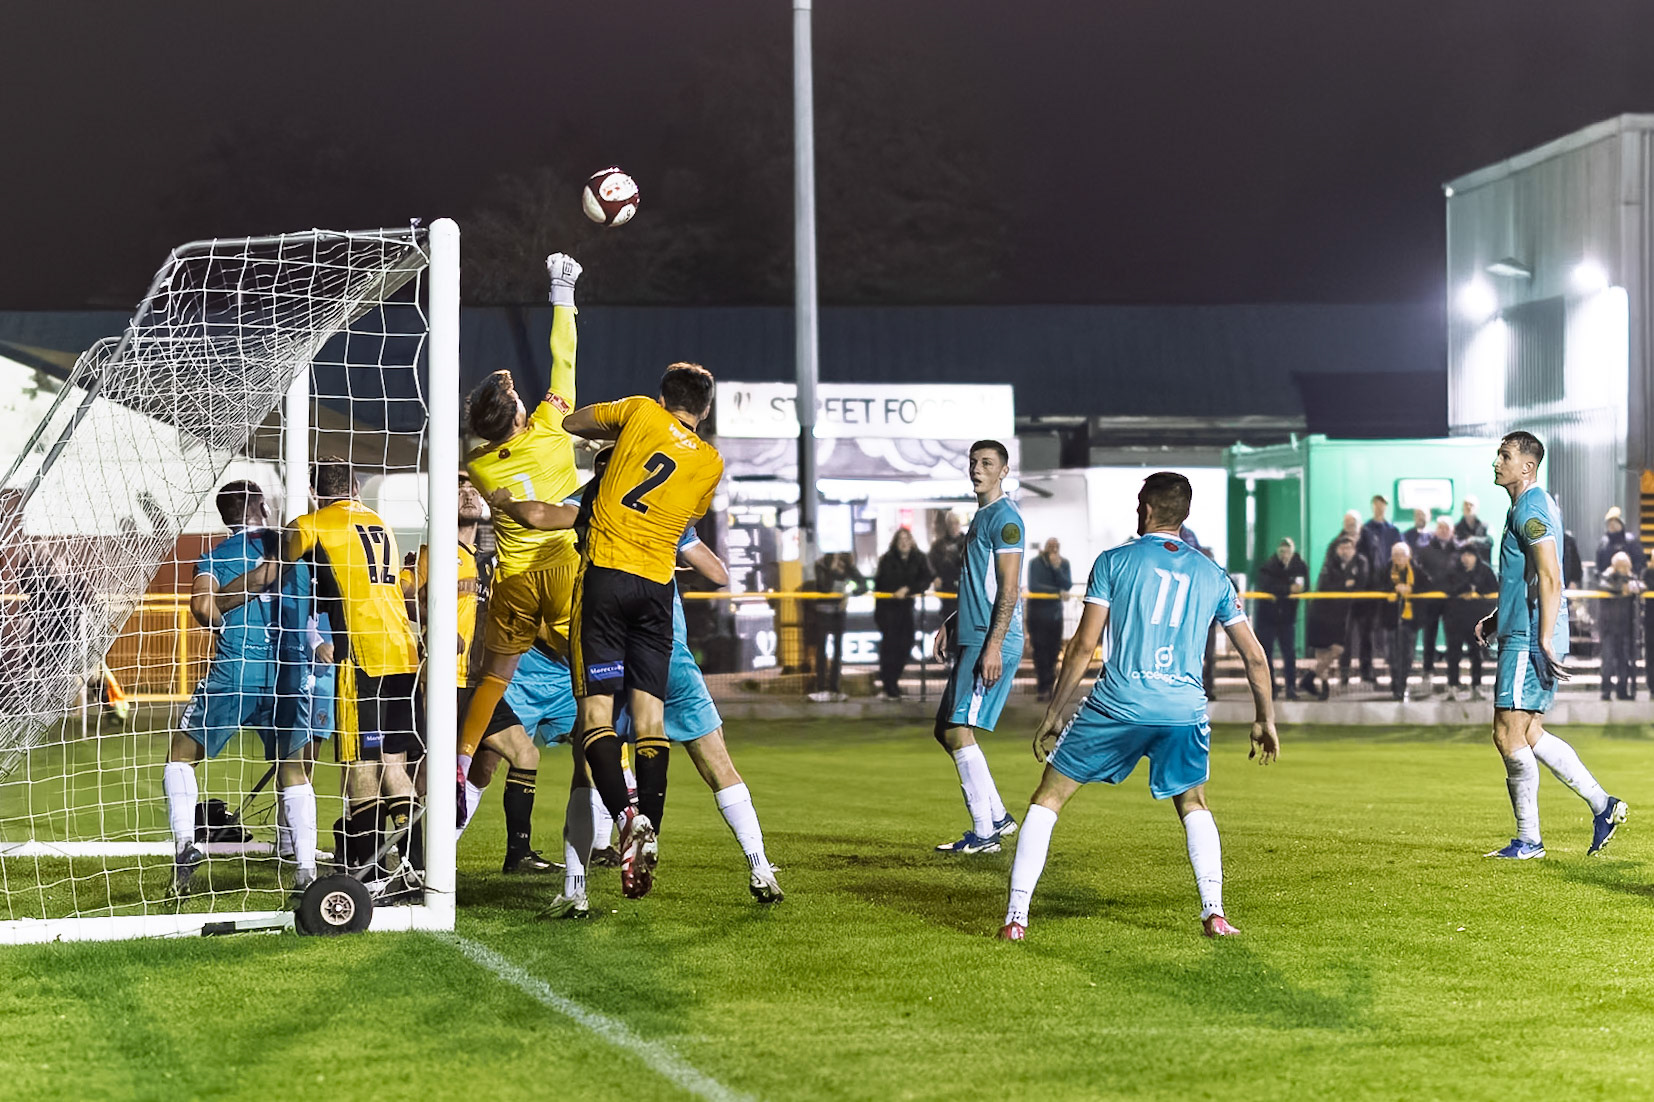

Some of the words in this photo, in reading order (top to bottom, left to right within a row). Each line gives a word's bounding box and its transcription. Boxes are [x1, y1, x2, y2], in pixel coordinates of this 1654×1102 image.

[769, 396, 876, 425] STEET
[621, 452, 677, 515] 2
[1150, 567, 1190, 628] 11
